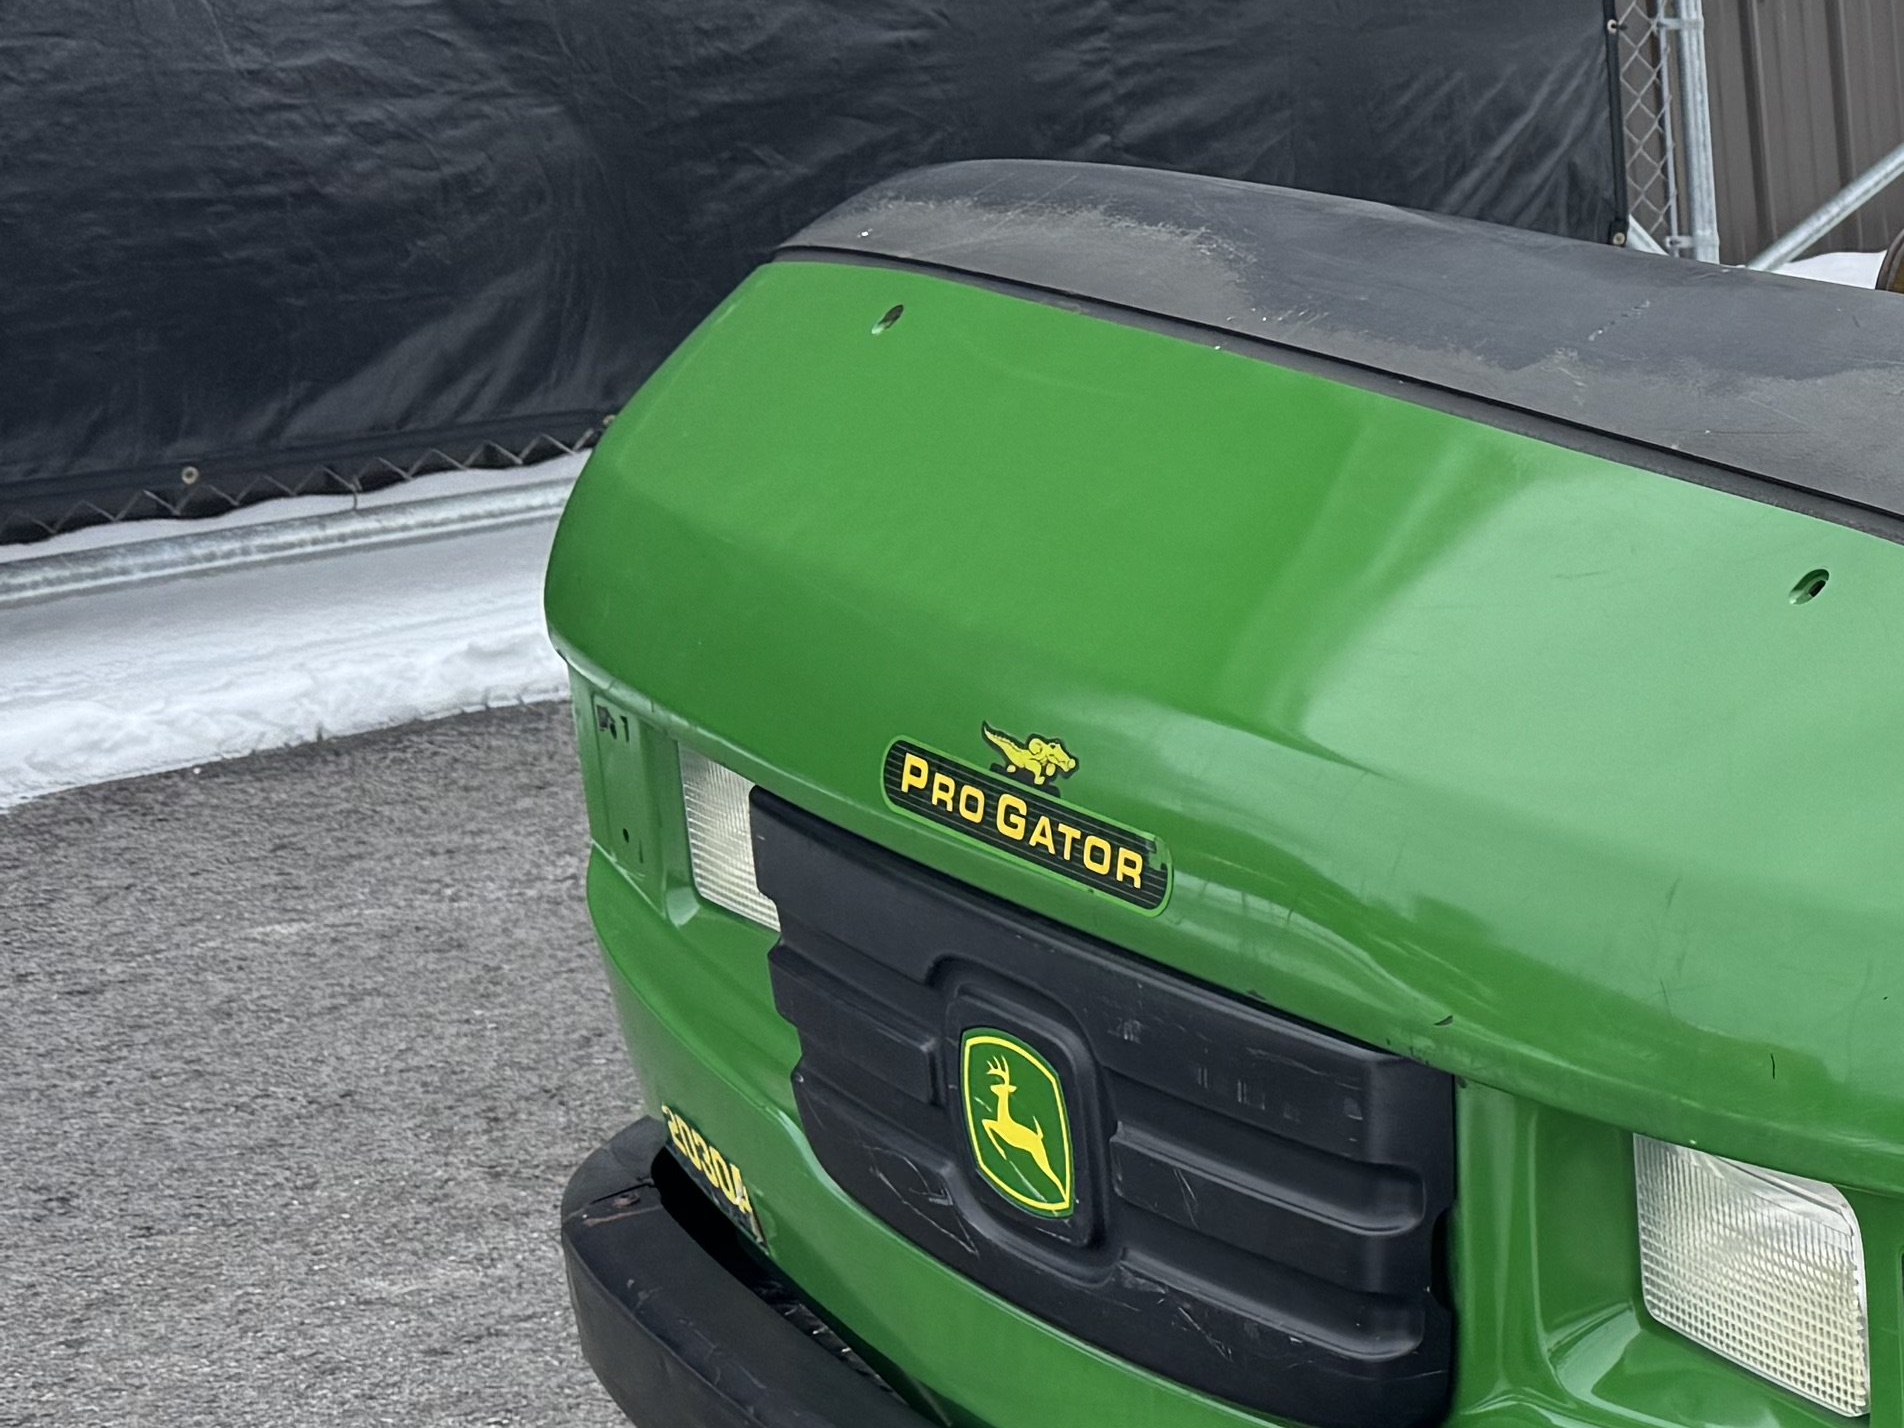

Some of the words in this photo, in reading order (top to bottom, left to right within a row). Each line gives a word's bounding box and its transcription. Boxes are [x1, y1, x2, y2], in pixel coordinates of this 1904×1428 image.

[901, 753, 984, 824] PRO
[996, 792, 1144, 889] GATOR
[660, 1104, 753, 1214] 2030A
